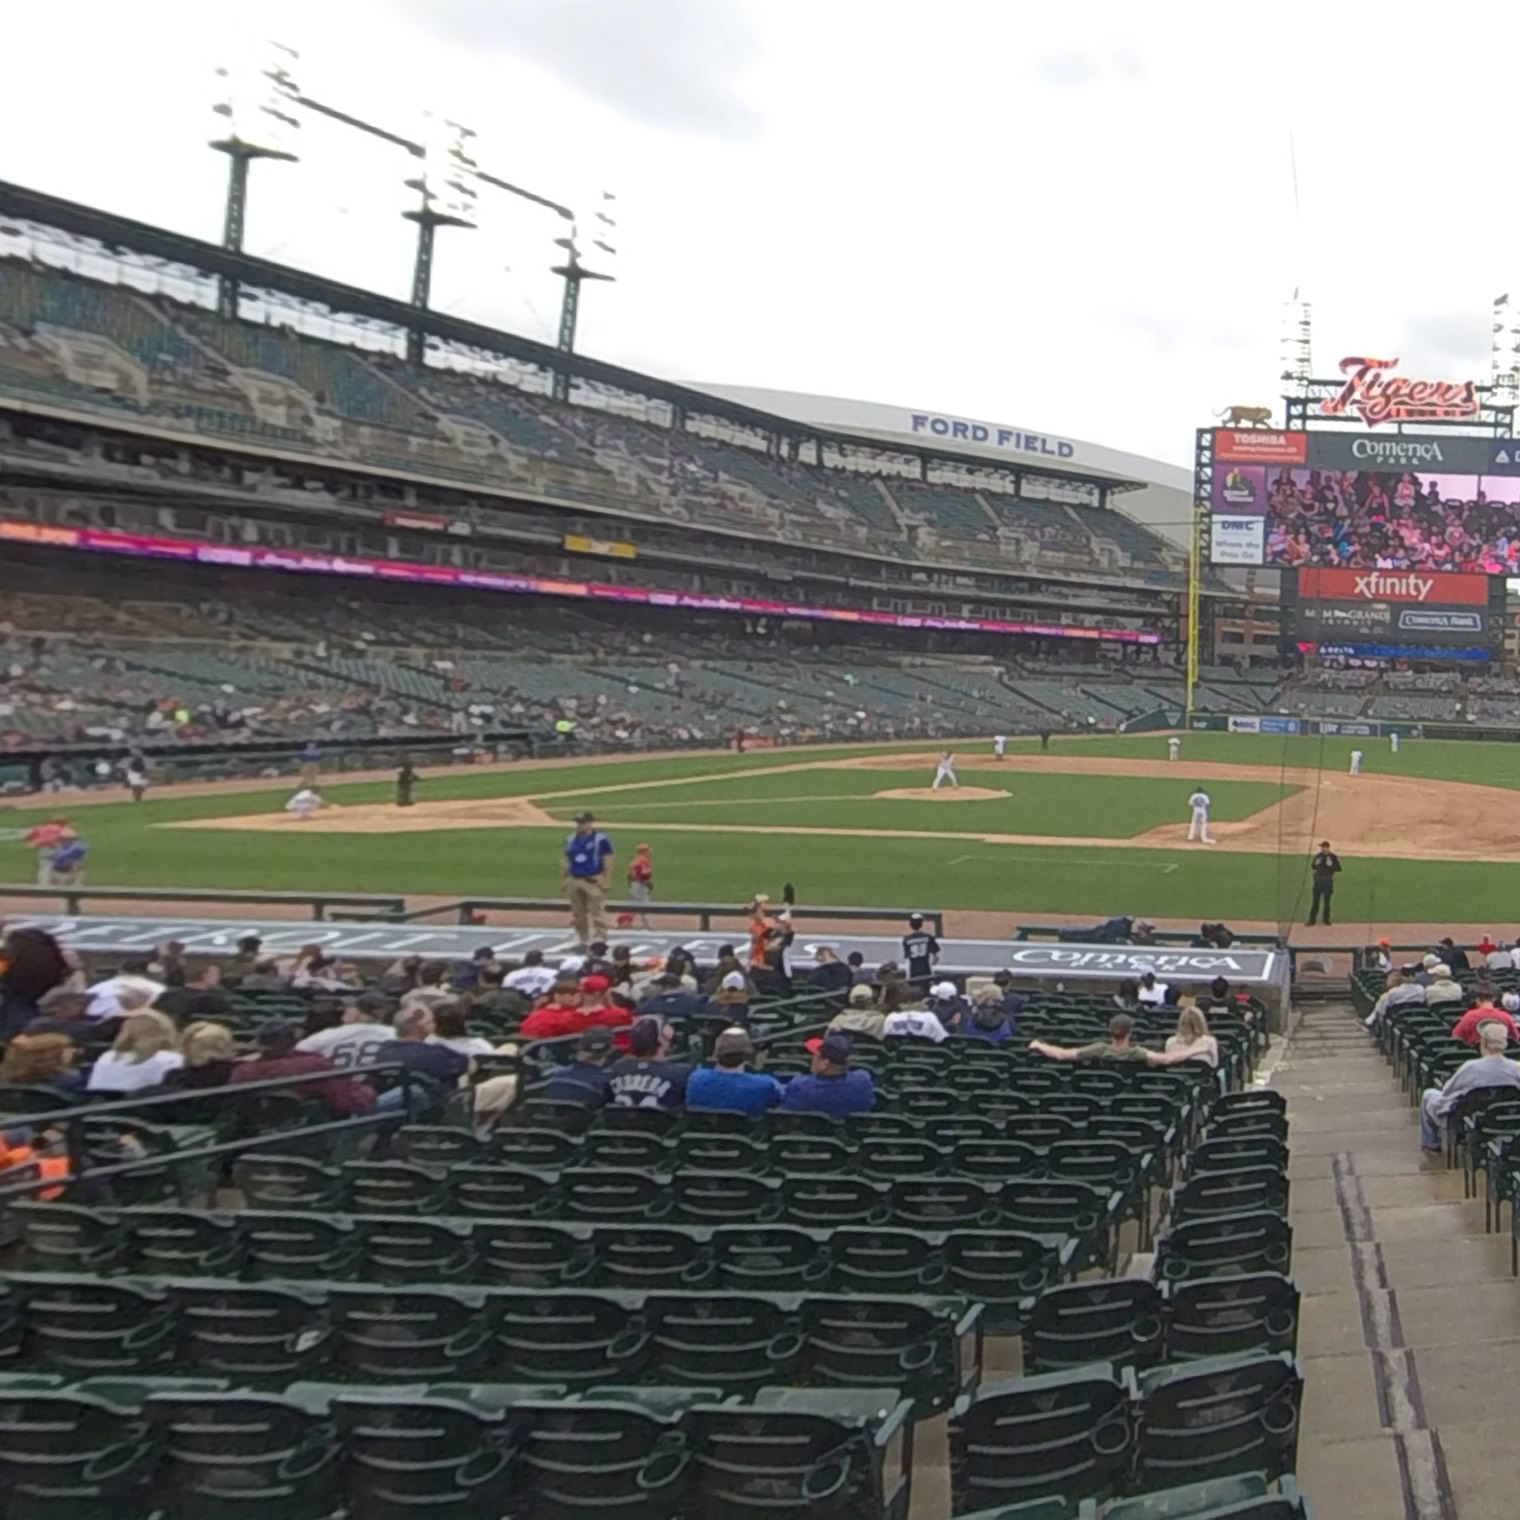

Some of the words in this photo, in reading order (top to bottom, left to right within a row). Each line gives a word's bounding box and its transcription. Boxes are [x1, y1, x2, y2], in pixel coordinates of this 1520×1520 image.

[1320, 357, 1477, 427] Tigers
[911, 414, 990, 442] FORD
[997, 429, 1075, 459] FIELD
[1232, 433, 1287, 446] TOSHIBA
[1376, 456, 1420, 465] PARK
[1354, 572, 1433, 601] xfinity
[1450, 617, 1475, 628] Bank
